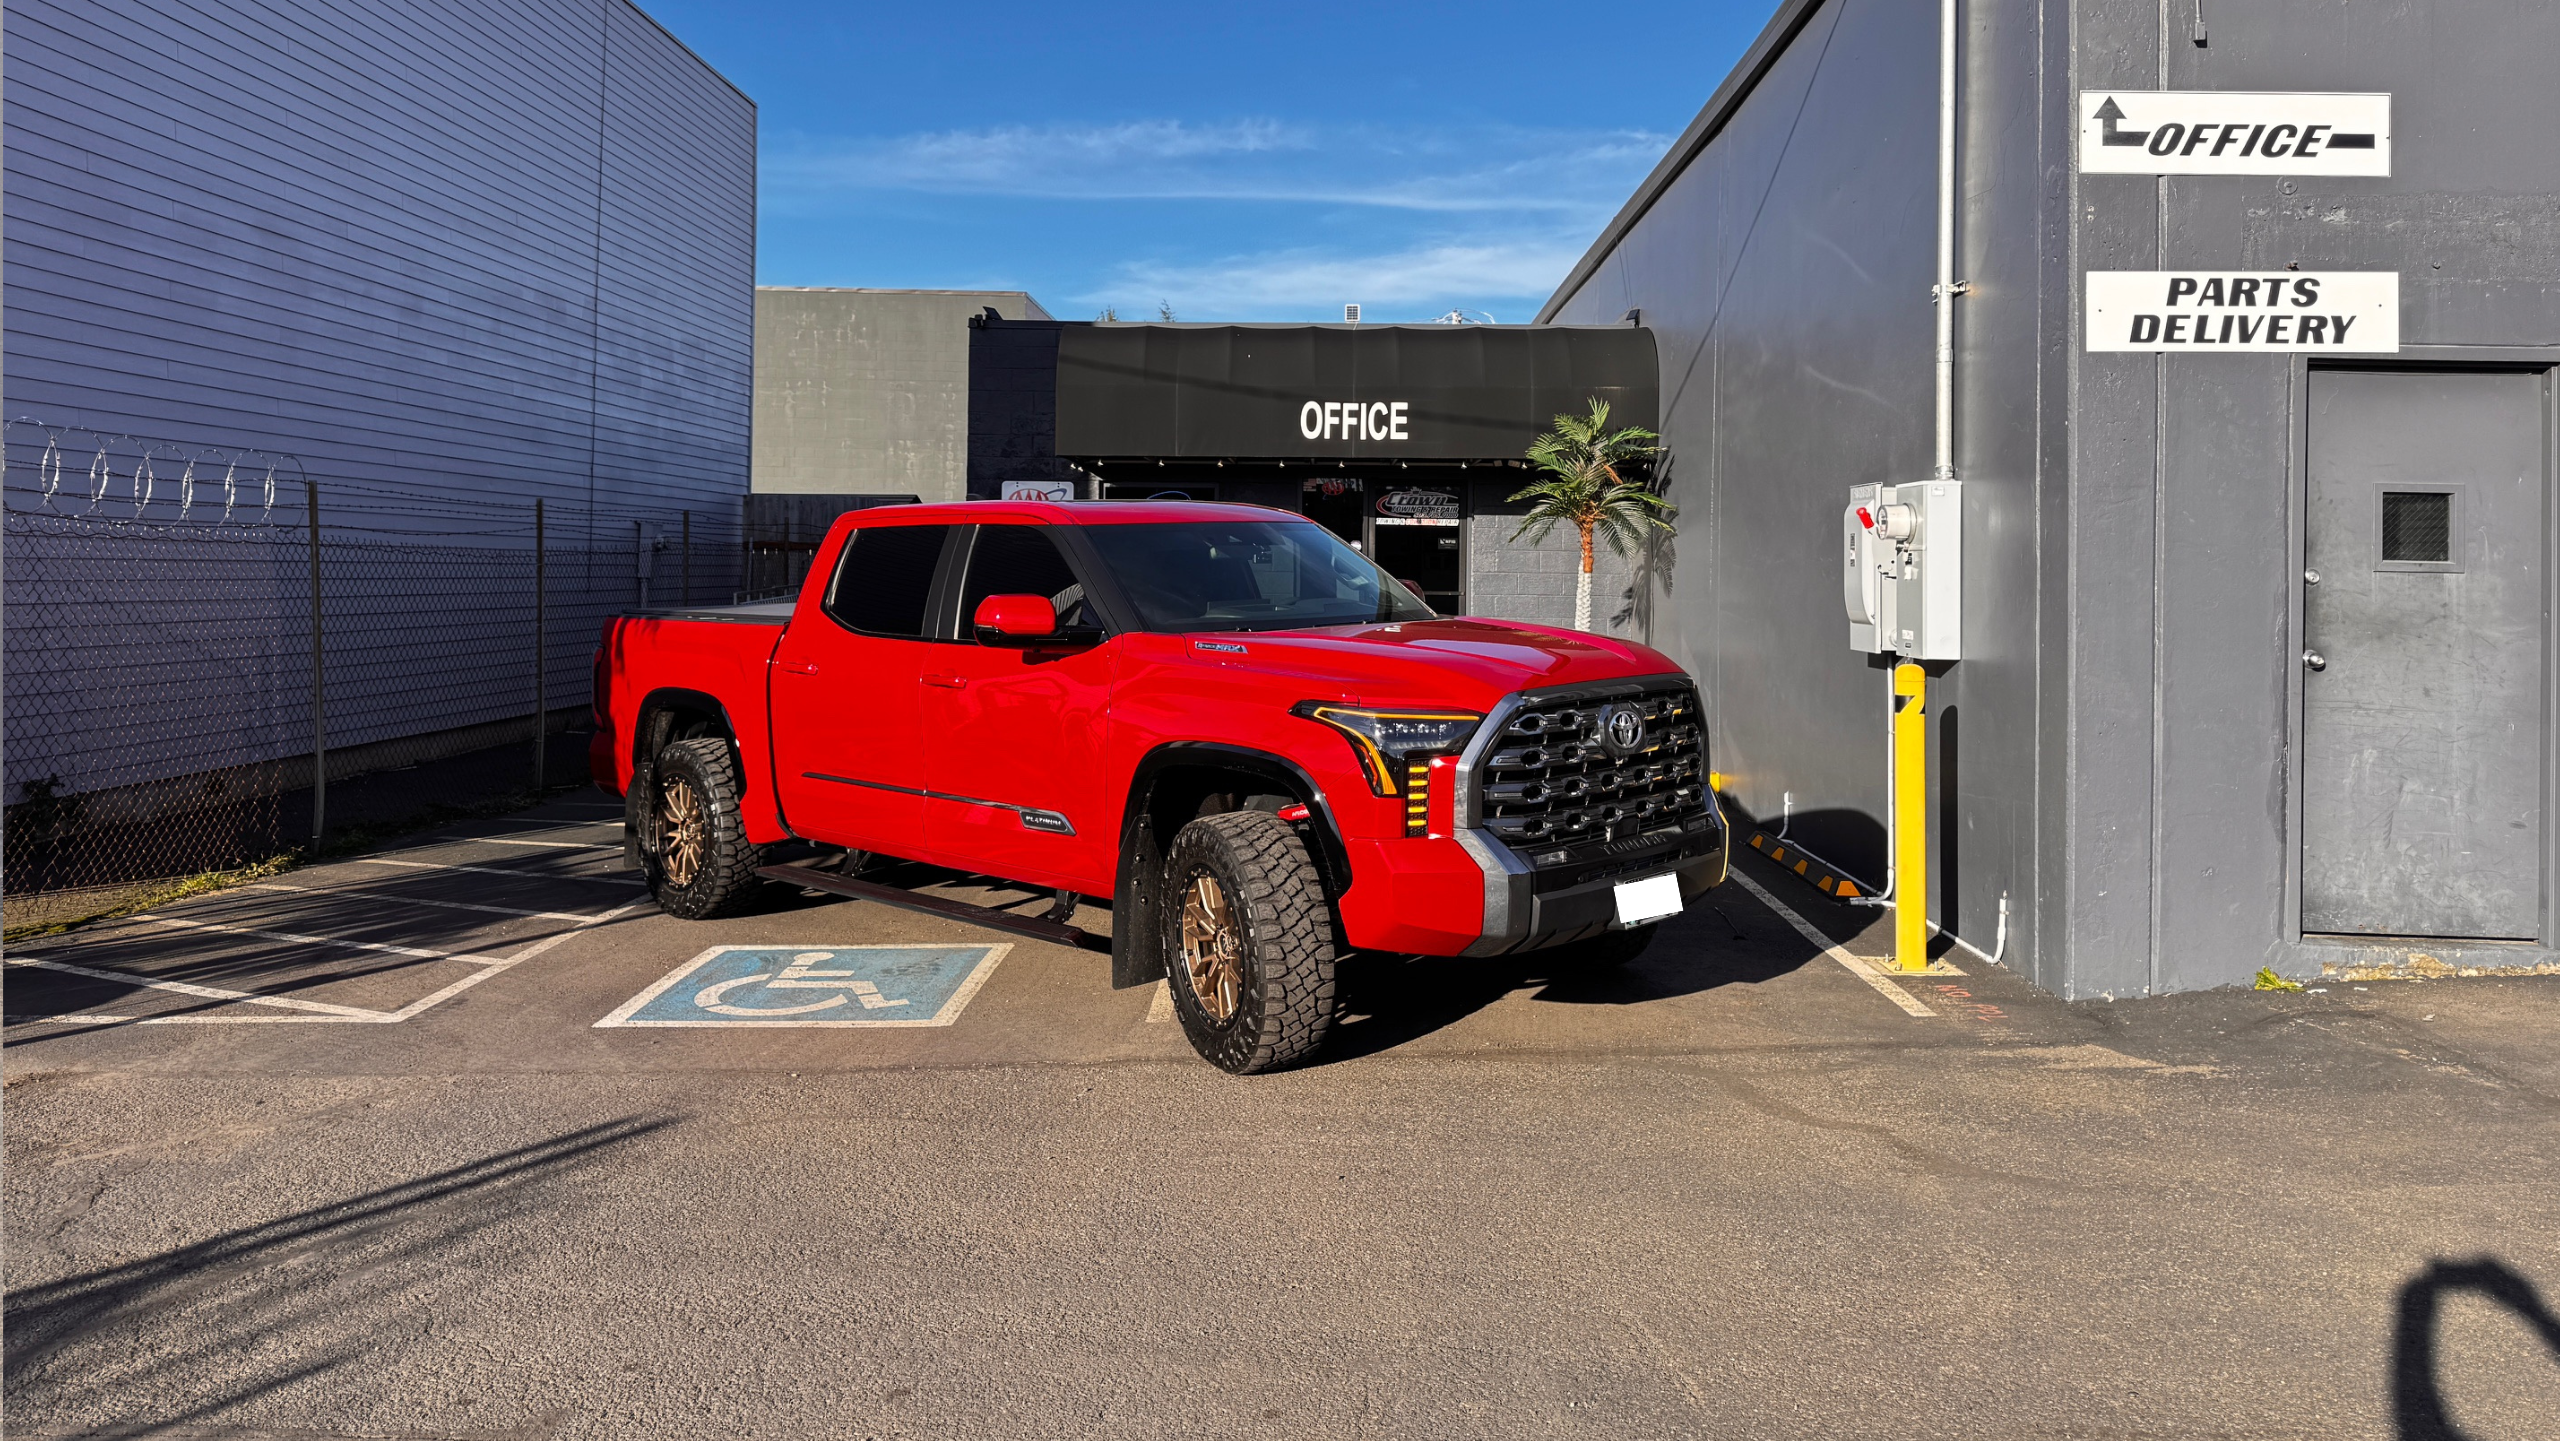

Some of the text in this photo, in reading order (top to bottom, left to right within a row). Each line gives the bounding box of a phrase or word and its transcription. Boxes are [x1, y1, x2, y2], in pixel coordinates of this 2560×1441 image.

[2147, 122, 2332, 158] OFFICE
[2166, 277, 2321, 308] PARTS
[2129, 314, 2358, 345] DELIVERY
[1300, 400, 1409, 441] OFFICE
[1386, 491, 1450, 506] Crown
[1391, 505, 1422, 513] TOWING
[1430, 506, 1460, 514] REPAIR
[1599, 834, 1667, 855] TUNDRA
